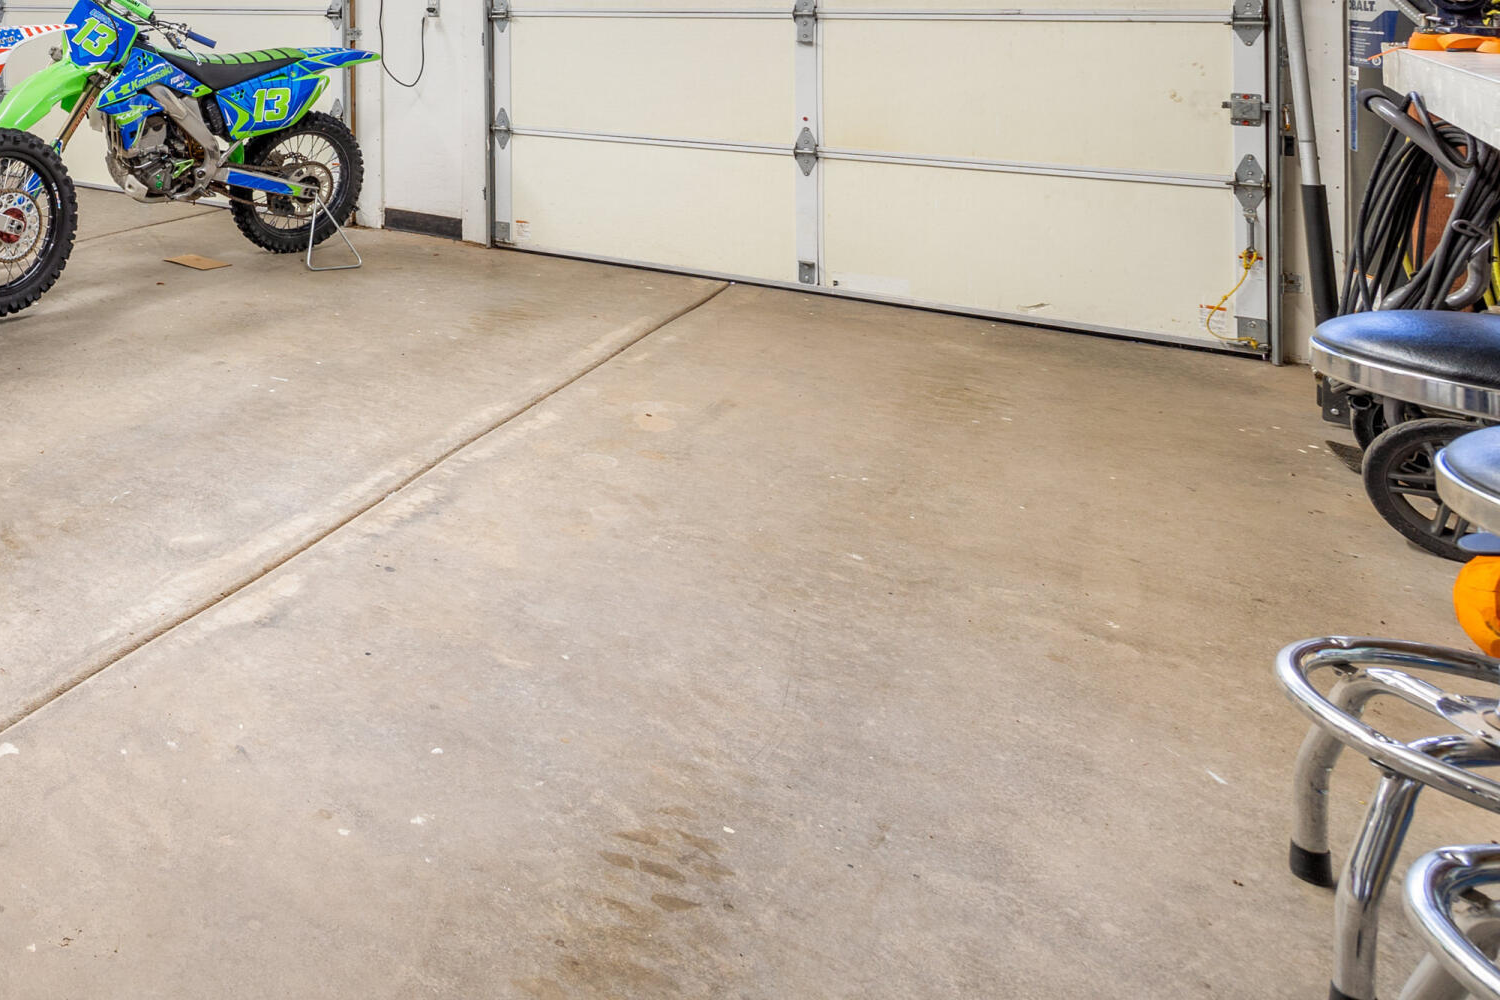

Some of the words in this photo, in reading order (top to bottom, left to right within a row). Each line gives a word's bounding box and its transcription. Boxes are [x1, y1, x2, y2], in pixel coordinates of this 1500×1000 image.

[71, 17, 120, 57] 13
[131, 64, 174, 91] Kawasaki
[253, 87, 291, 123] 13
